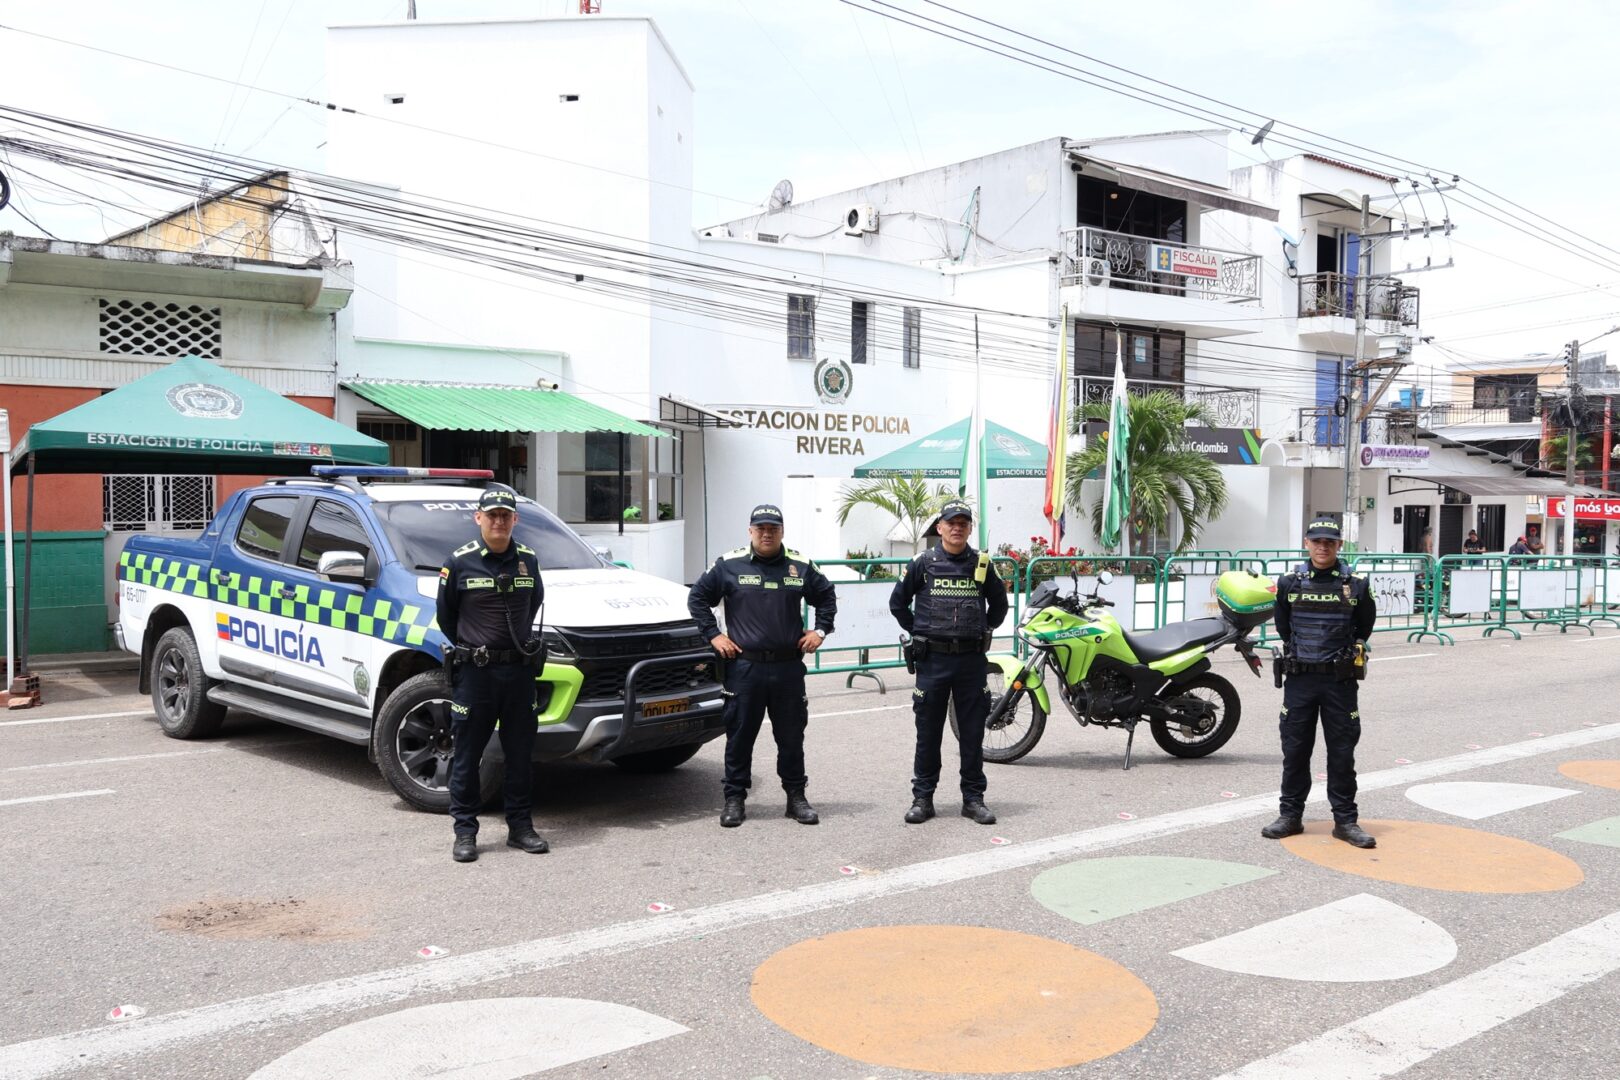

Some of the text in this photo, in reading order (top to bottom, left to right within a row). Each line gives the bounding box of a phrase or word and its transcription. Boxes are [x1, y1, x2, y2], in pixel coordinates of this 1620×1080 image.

[1173, 250, 1217, 266] FISCALIA
[716, 410, 911, 434] ESTACION DE POLICIA
[176, 437, 197, 449] DE
[797, 435, 865, 456] RIVERA
[1191, 441, 1229, 454] Colombia
[1575, 501, 1602, 513] más
[934, 577, 977, 589] POLICÍA
[229, 623, 325, 667] POLICÍA
